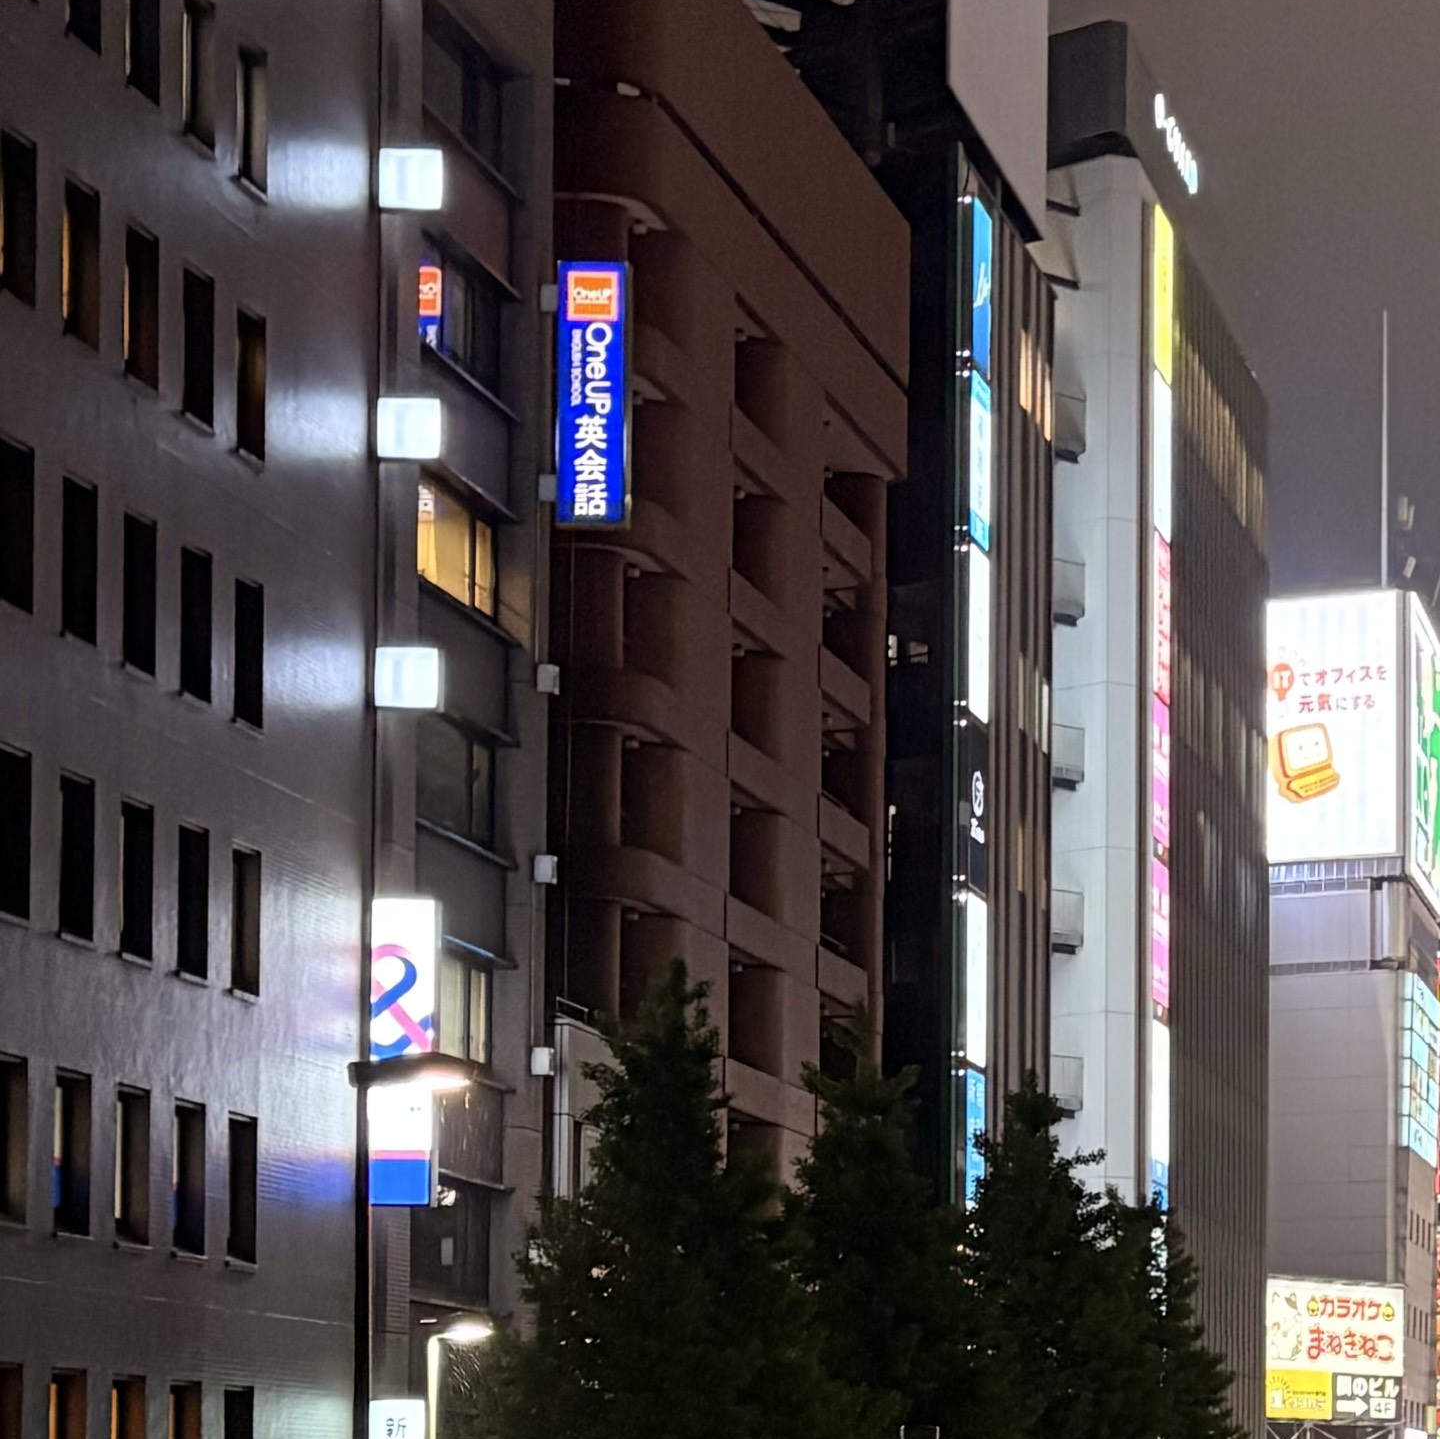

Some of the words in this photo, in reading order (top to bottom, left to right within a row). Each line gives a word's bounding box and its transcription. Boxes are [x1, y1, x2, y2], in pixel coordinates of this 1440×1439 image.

[585, 322, 613, 415] OneUP
[574, 414, 609, 517] 英会話
[1319, 1295, 1383, 1321] カラオケ
[1307, 1324, 1396, 1362] まねきねこ
